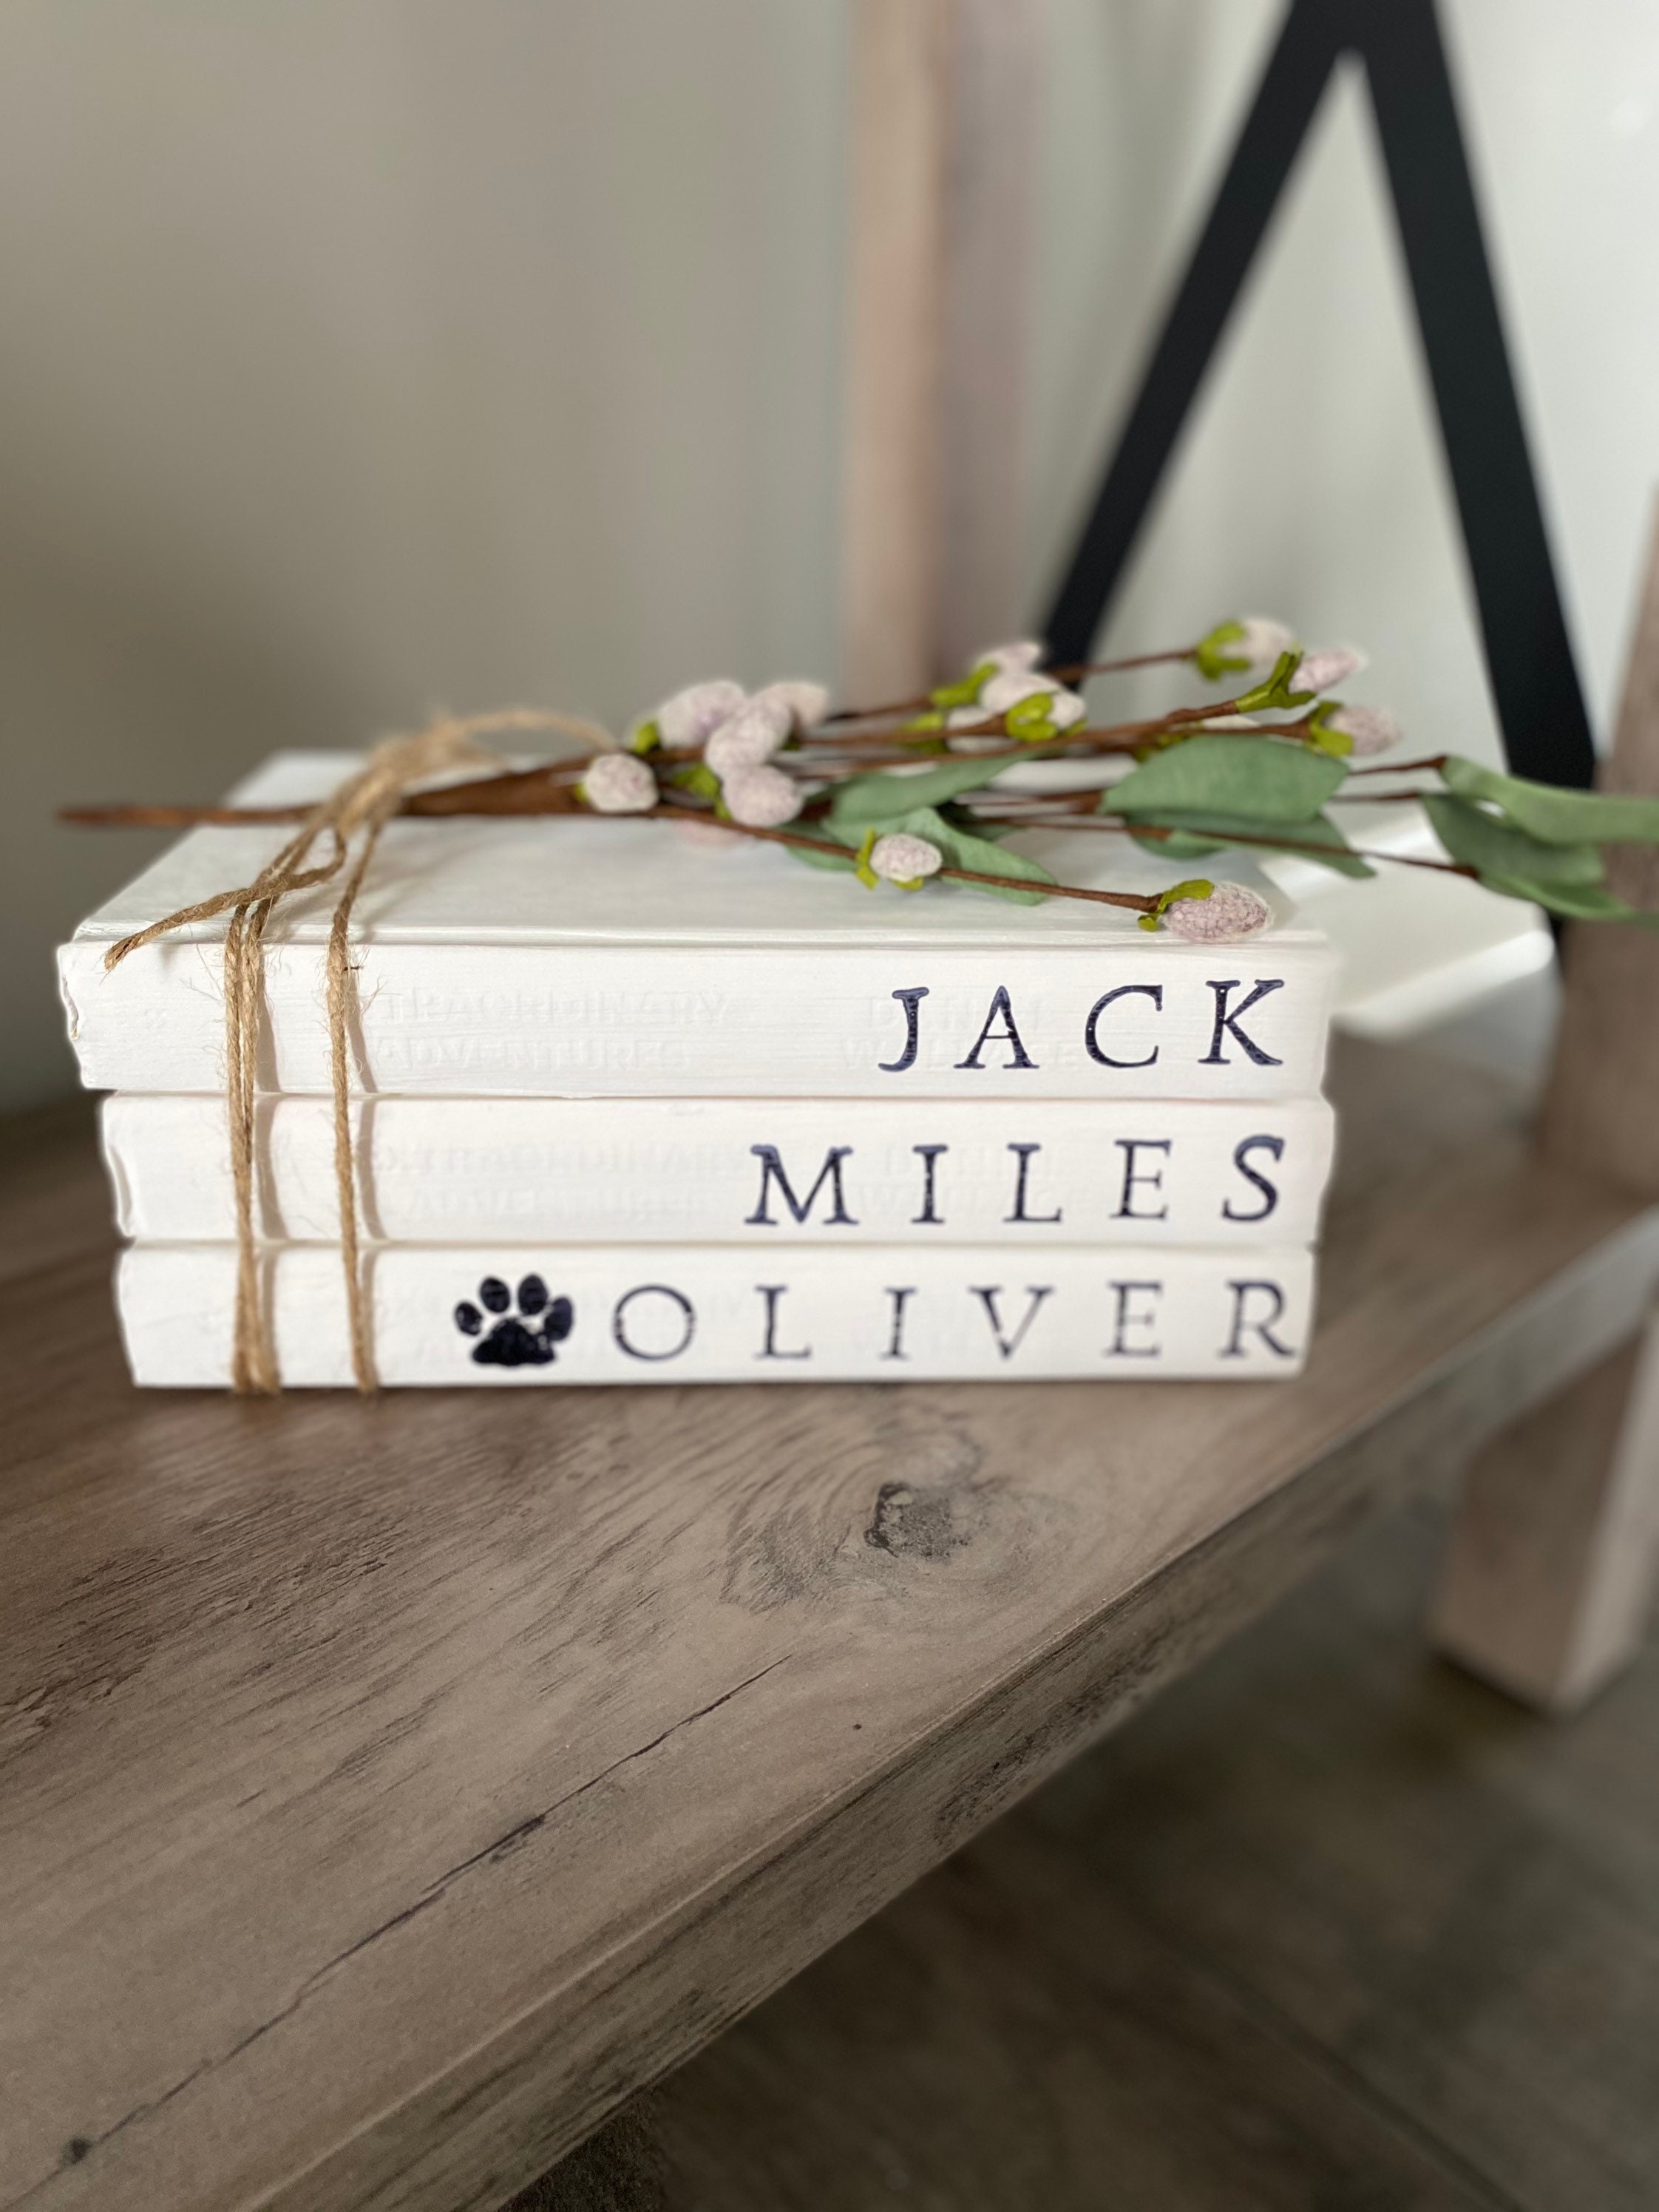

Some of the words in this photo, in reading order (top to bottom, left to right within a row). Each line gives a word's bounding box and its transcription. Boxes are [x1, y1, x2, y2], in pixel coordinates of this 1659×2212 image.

[878, 978, 1285, 1072] JACK
[745, 1135, 1286, 1226] MILES
[612, 1280, 1297, 1362] OLIVER
